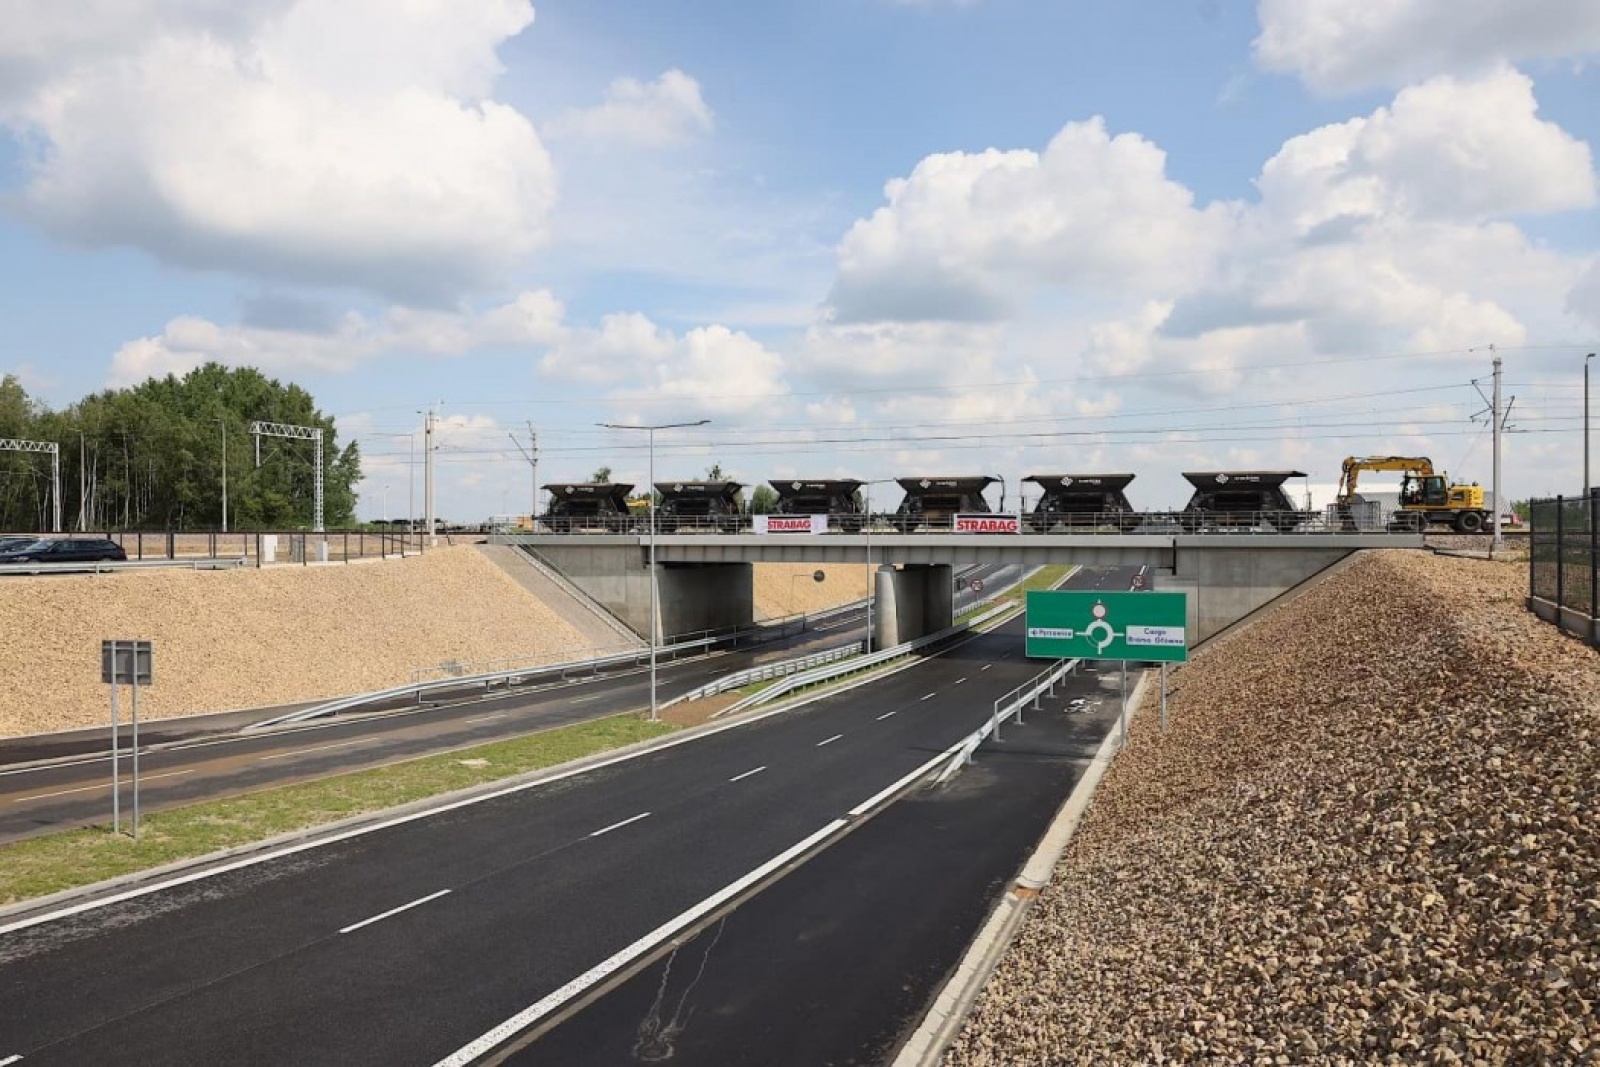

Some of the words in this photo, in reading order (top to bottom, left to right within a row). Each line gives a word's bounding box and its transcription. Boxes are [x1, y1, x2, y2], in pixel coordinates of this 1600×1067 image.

[768, 520, 811, 530] STRABAG
[957, 520, 1017, 530] STRABAG
[1144, 628, 1166, 636] Cargo
